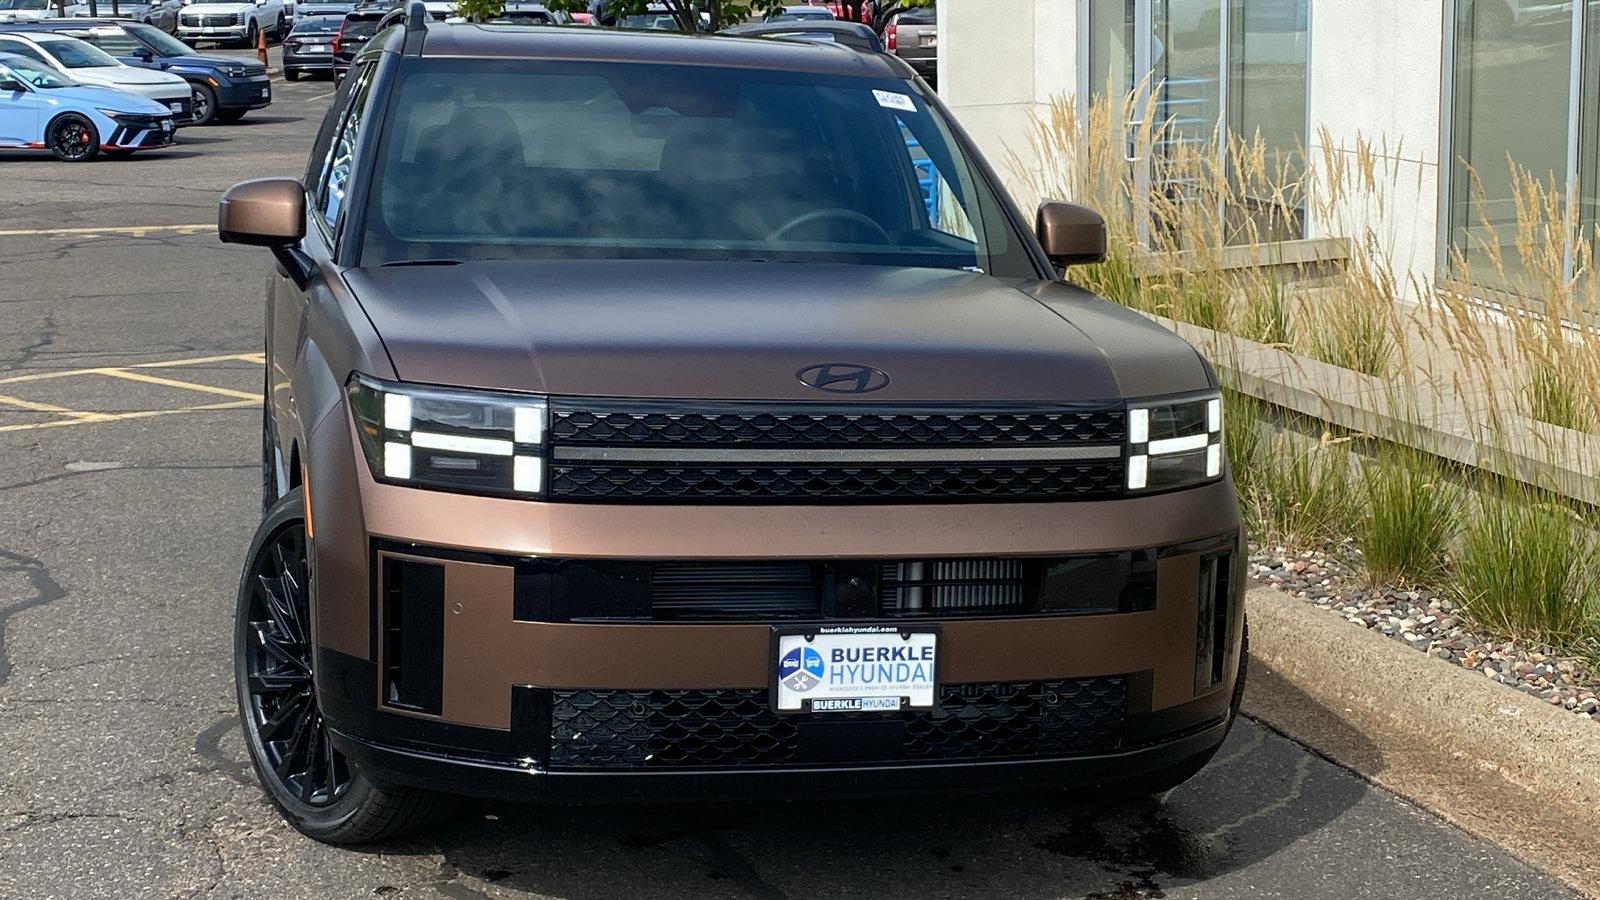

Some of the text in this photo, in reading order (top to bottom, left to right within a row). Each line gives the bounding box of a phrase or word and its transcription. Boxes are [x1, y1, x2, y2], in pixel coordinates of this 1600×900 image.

[820, 626, 898, 634] buerklehyundai.com
[831, 646, 933, 662] BUERKLE
[830, 663, 933, 684] HYUNDAI
[813, 698, 899, 710] BUERKLE HYUNDAI
